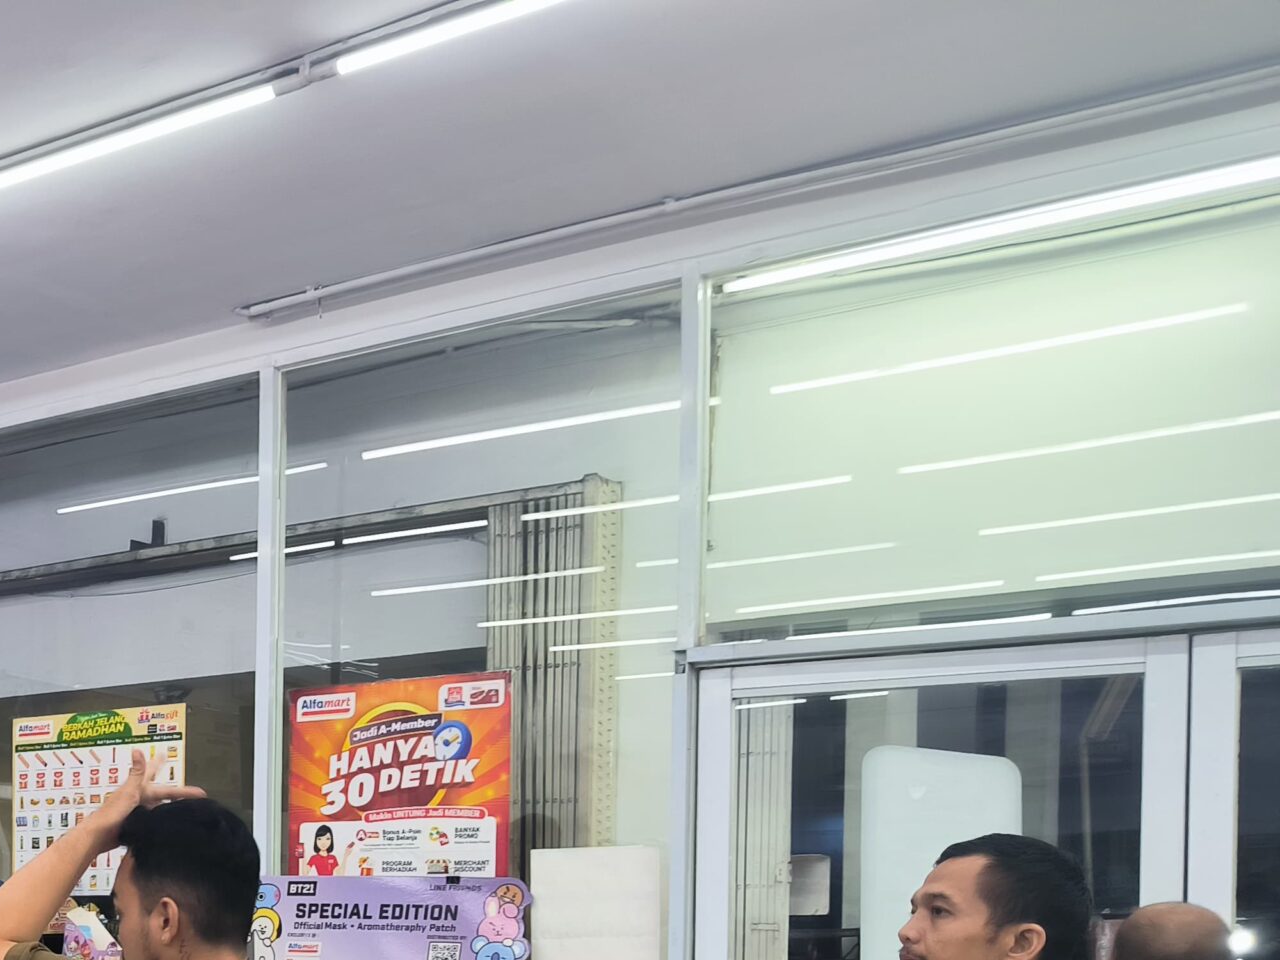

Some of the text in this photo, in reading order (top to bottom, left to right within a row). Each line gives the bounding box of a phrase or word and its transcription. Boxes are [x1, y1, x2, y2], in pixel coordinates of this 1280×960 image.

[301, 697, 351, 711] Alfamart
[18, 723, 51, 733] Alfamart
[63, 723, 125, 741] RAMADHAN
[352, 717, 438, 742] Jadi A-Member
[328, 735, 437, 778] HANYA
[320, 758, 481, 816] 30 DETIK
[393, 808, 425, 819] UNTUNG
[289, 884, 314, 895] BT21
[295, 903, 459, 921] SPECIAL EDITION
[294, 921, 456, 934] Official Mask Aromatheraphy Patch
[288, 942, 319, 950] Alfamart
